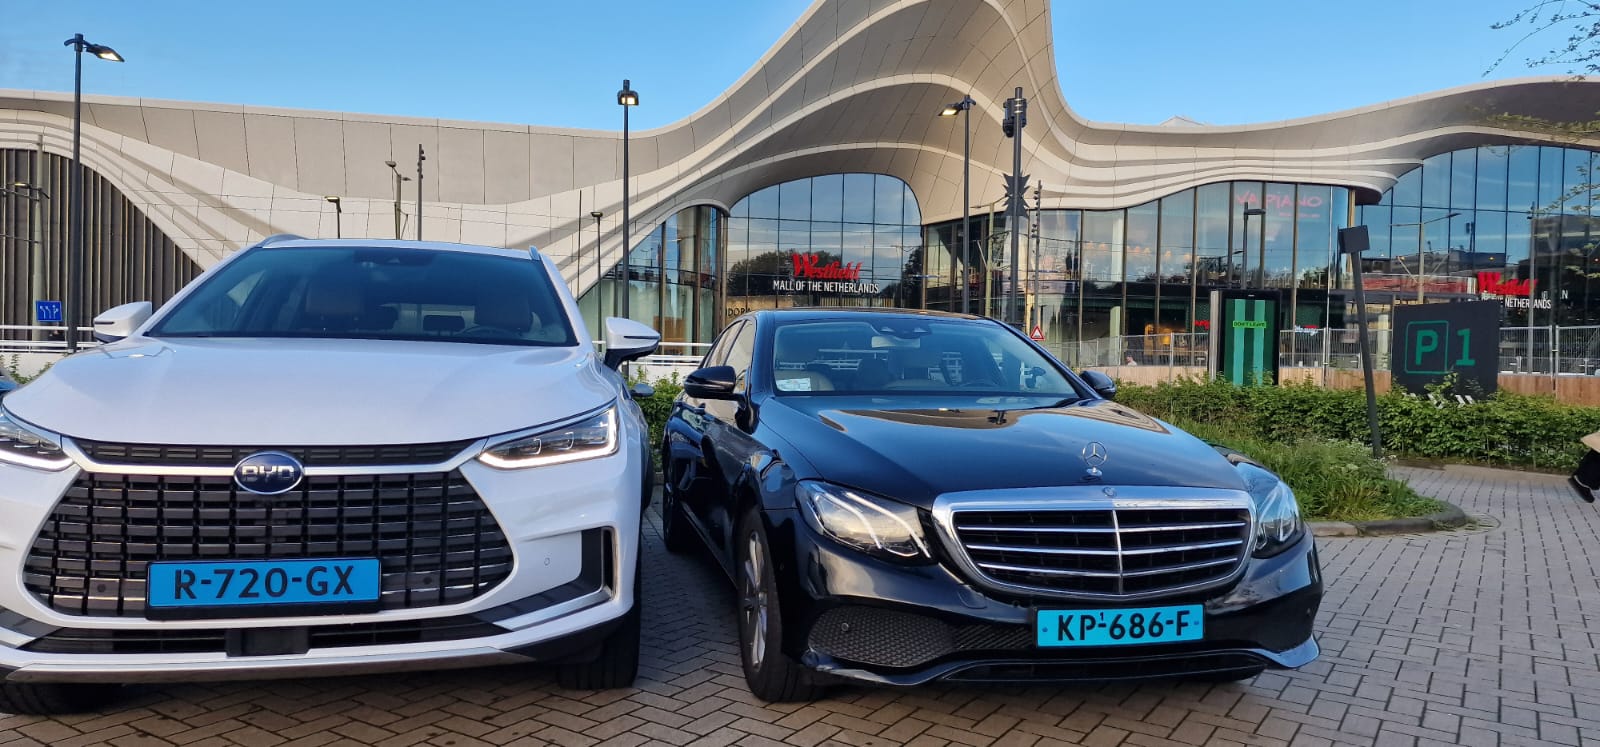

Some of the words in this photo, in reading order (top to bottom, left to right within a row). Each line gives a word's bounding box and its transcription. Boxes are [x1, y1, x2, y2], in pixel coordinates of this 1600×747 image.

[792, 252, 863, 279] Westfield
[773, 280, 794, 291] MALL
[796, 281, 806, 291] OF
[808, 281, 822, 292] THE
[824, 282, 880, 294] NETHERLANDS
[1505, 299, 1551, 309] NETHERANDS
[1415, 329, 1439, 366] P
[1455, 328, 1476, 366] 1
[242, 465, 295, 481] BYD
[174, 565, 354, 600] R-720-GX
